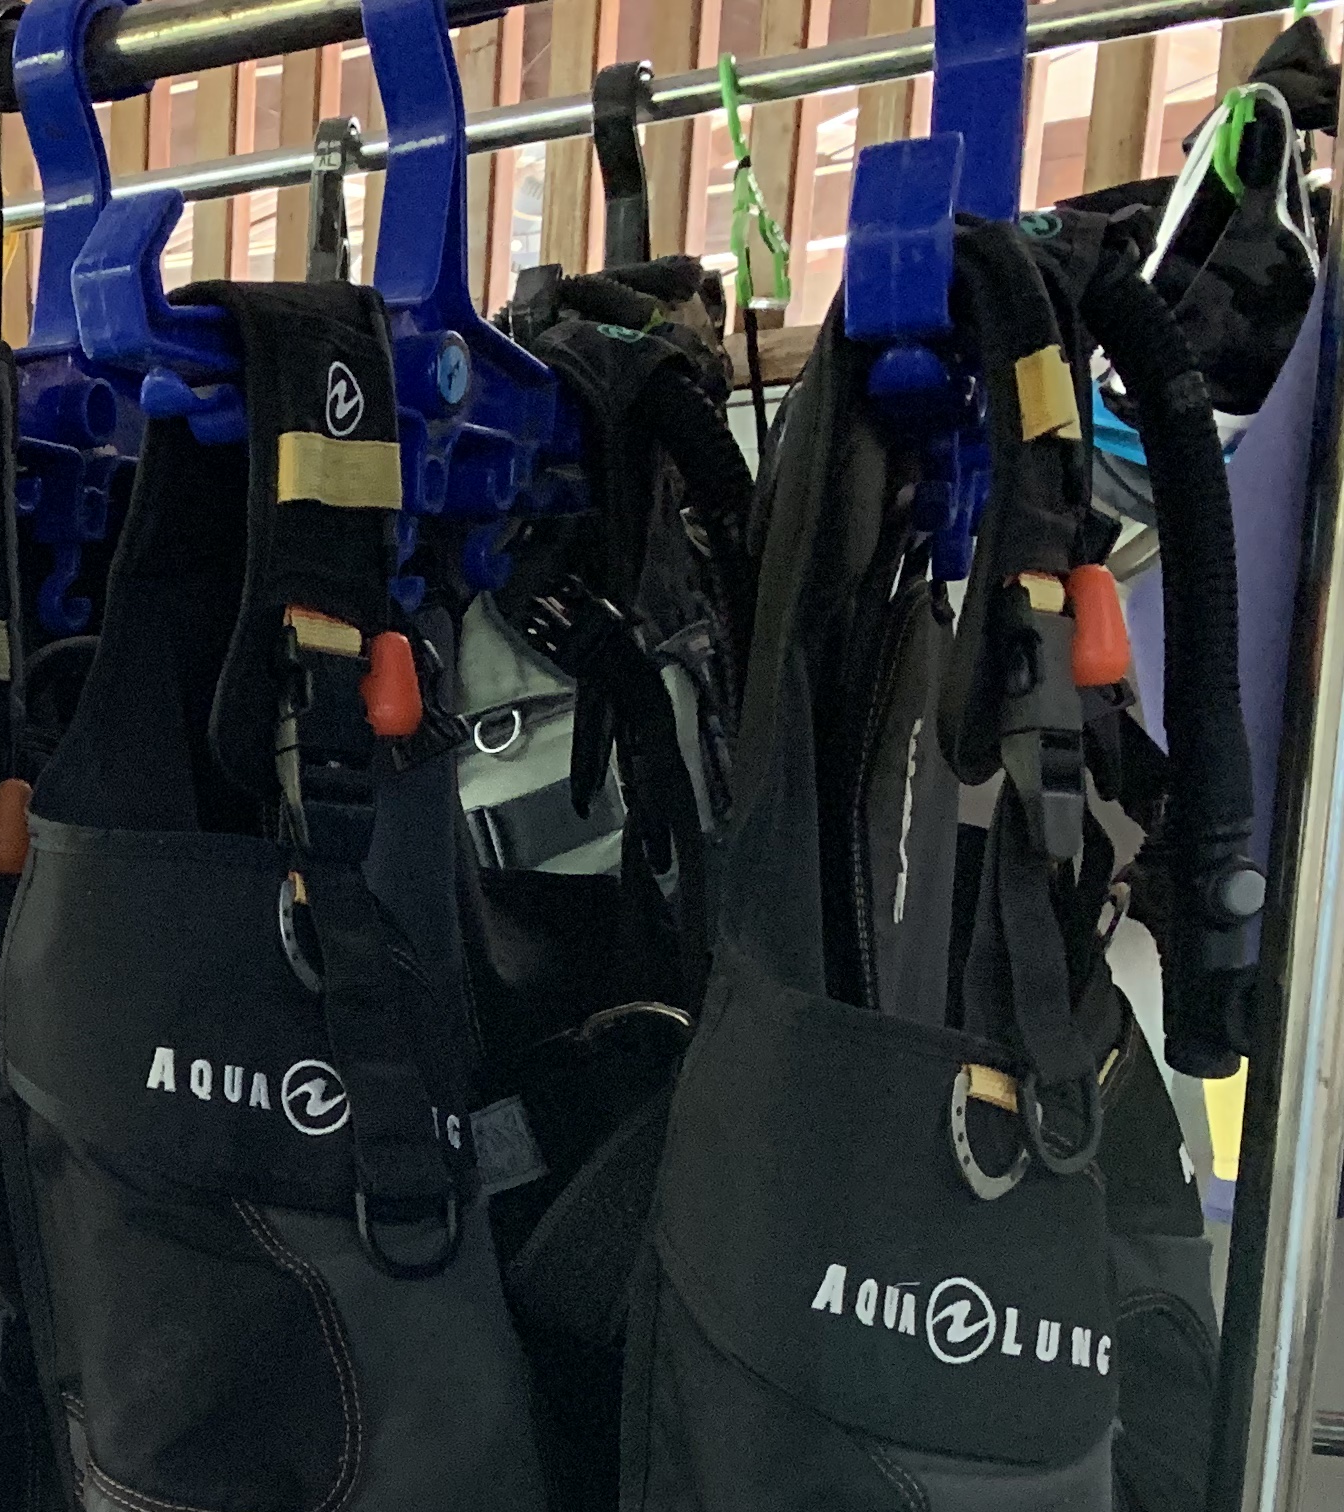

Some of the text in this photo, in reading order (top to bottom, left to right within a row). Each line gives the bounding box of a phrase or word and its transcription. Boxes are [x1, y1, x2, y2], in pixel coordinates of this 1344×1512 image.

[147, 1046, 271, 1111] AQUA
[811, 1263, 1111, 1376] AQUA LUNG
